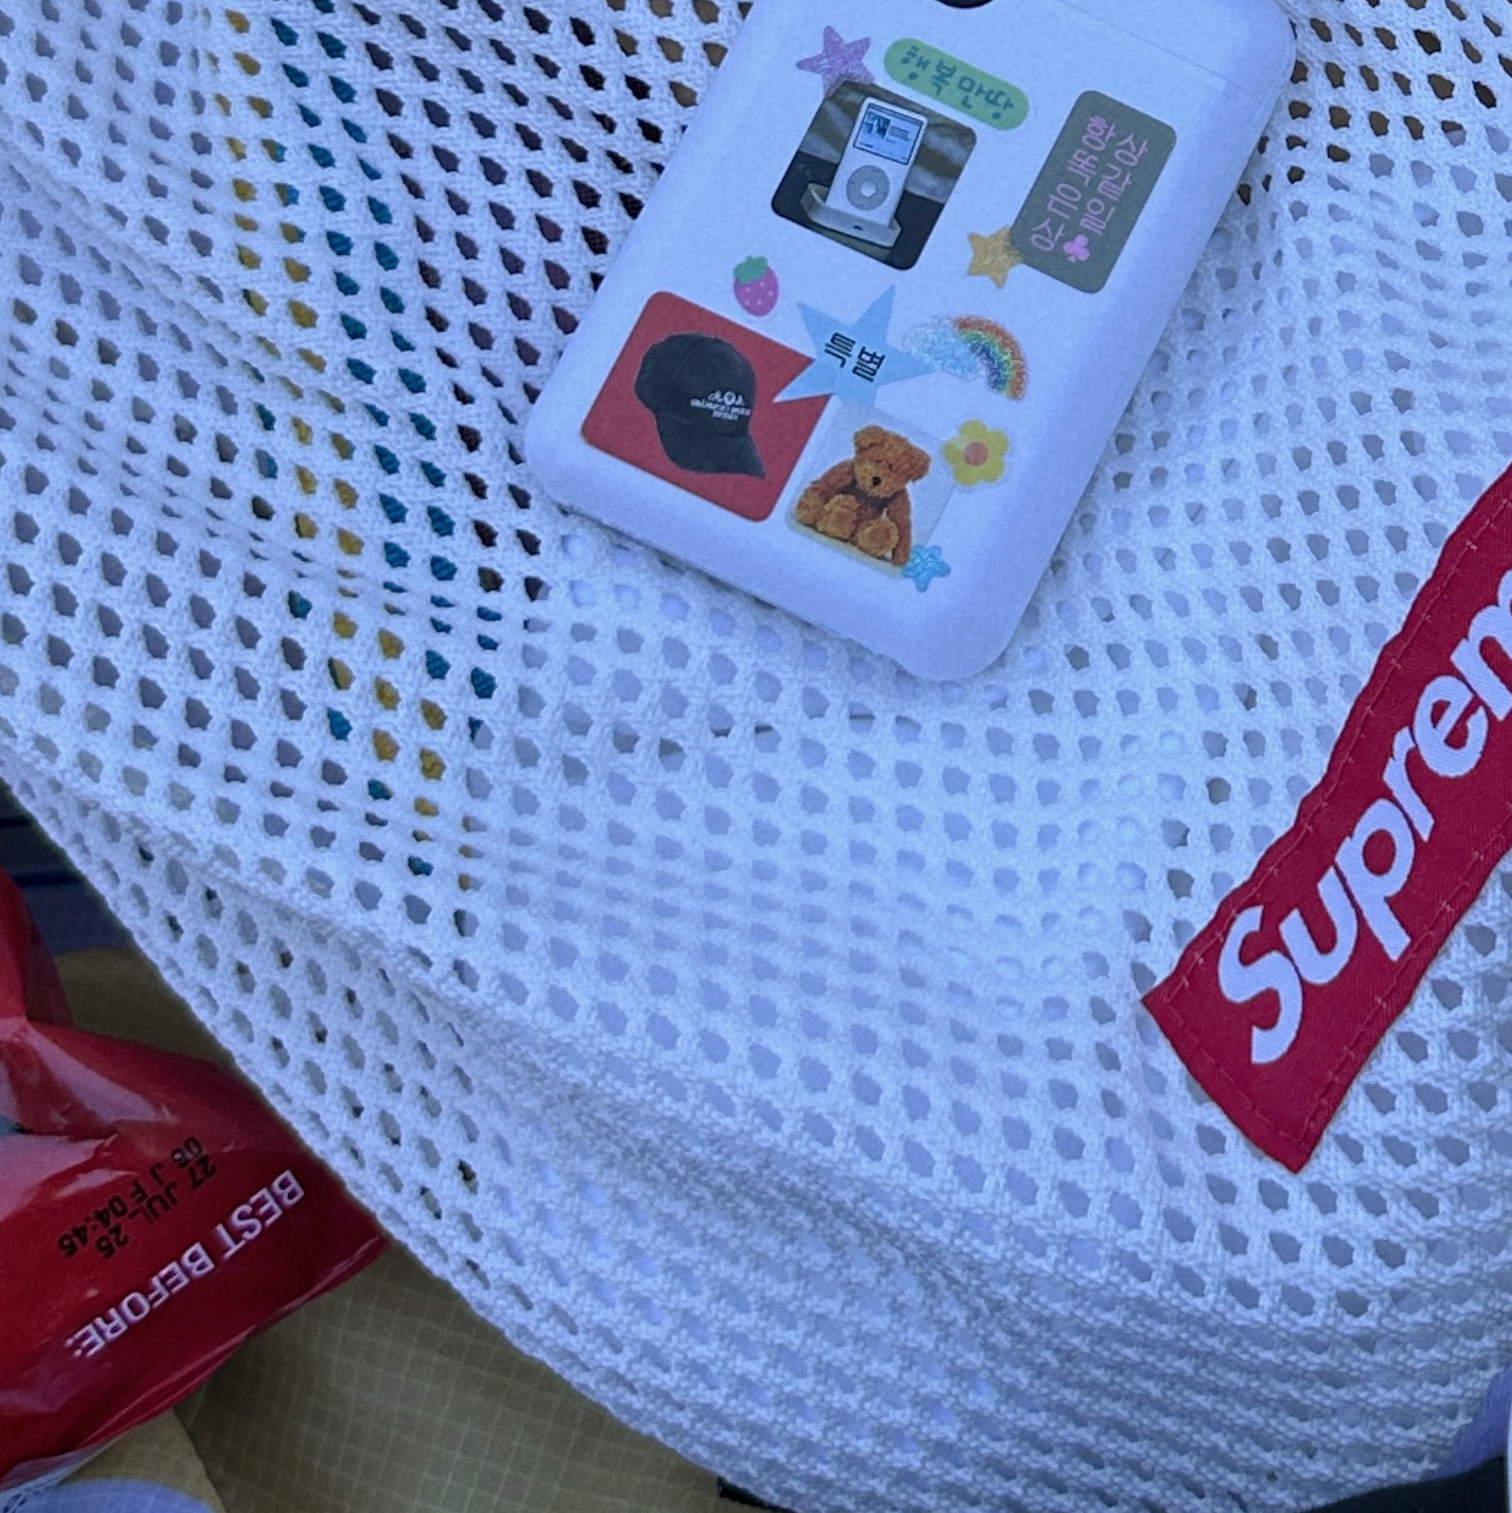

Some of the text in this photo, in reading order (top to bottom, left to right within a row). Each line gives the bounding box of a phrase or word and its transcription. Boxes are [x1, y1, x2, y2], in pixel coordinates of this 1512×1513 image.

[823, 332, 887, 383] 특별
[150, 1161, 165, 1185] J
[58, 1195, 128, 1258] 04:45
[95, 1153, 217, 1258] 27 JUL 25
[65, 1169, 305, 1359] BEST BEFORE:
